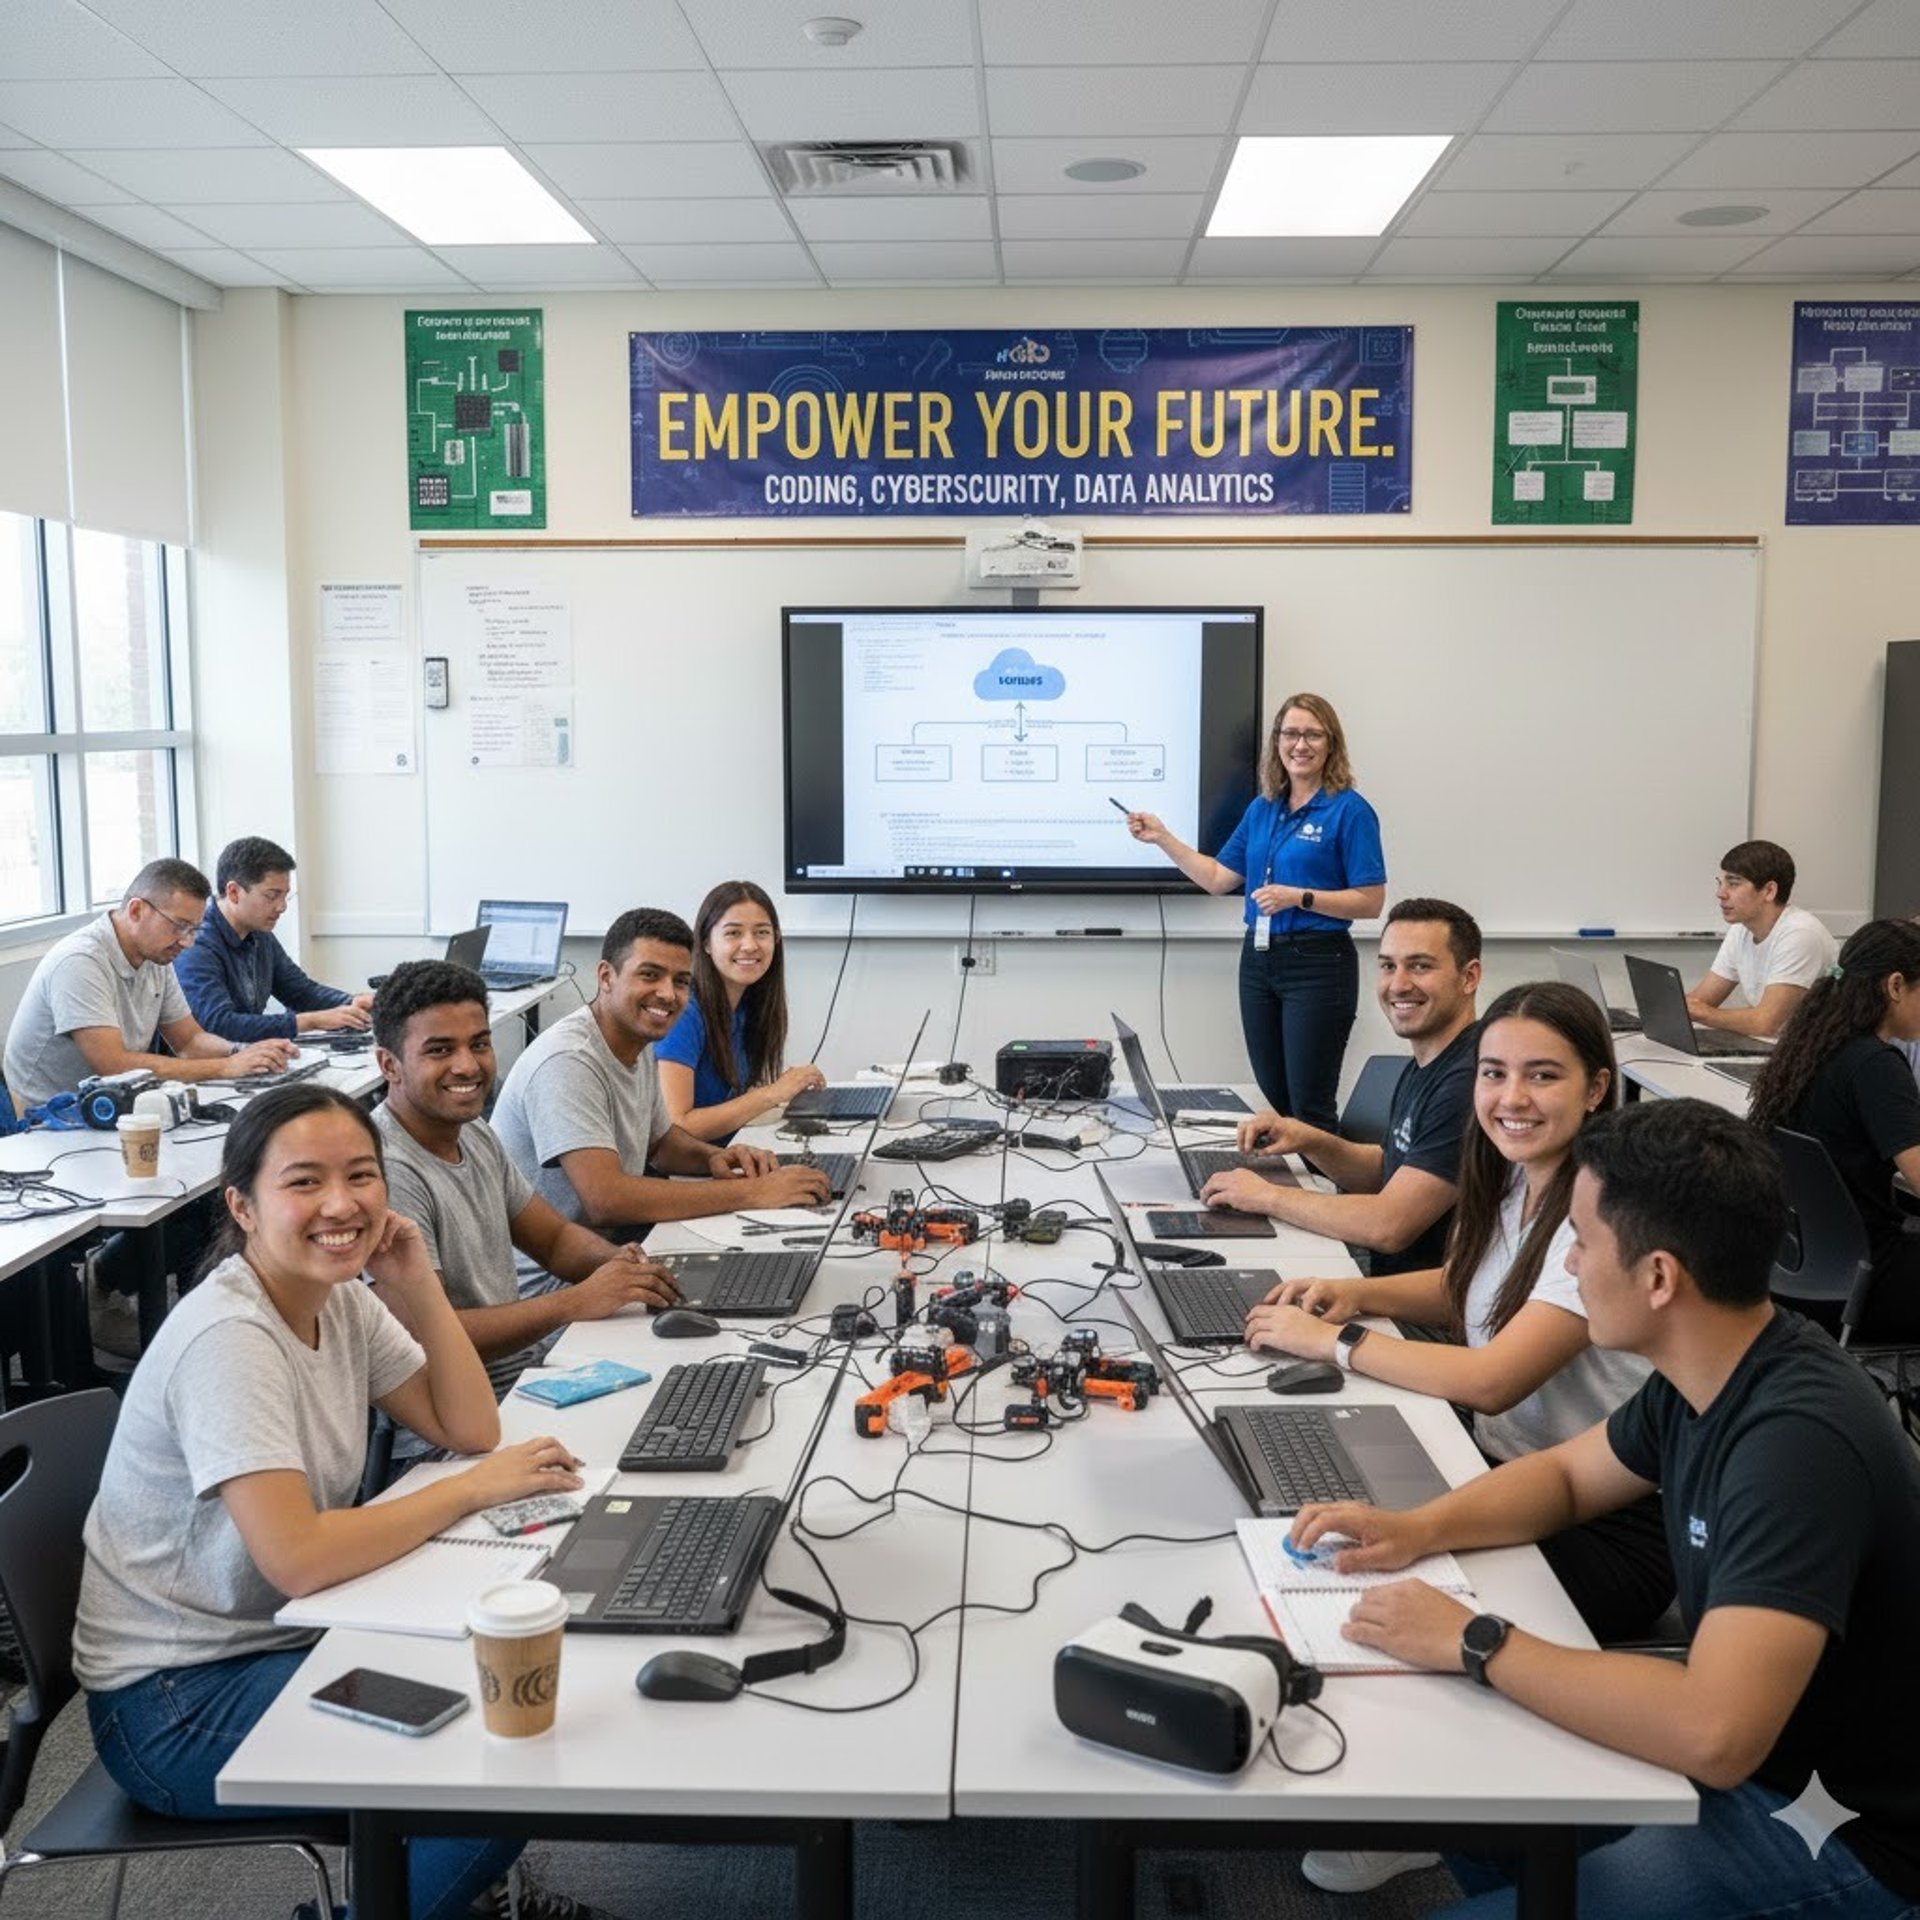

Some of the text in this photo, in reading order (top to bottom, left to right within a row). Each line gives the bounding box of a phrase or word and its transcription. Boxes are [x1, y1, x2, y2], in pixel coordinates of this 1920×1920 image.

[658, 388, 1395, 461] EMPOWER YOUR FUTURE.
[764, 472, 1275, 510] CODING, CYBERSCURITY, DATA ANALYTICS
